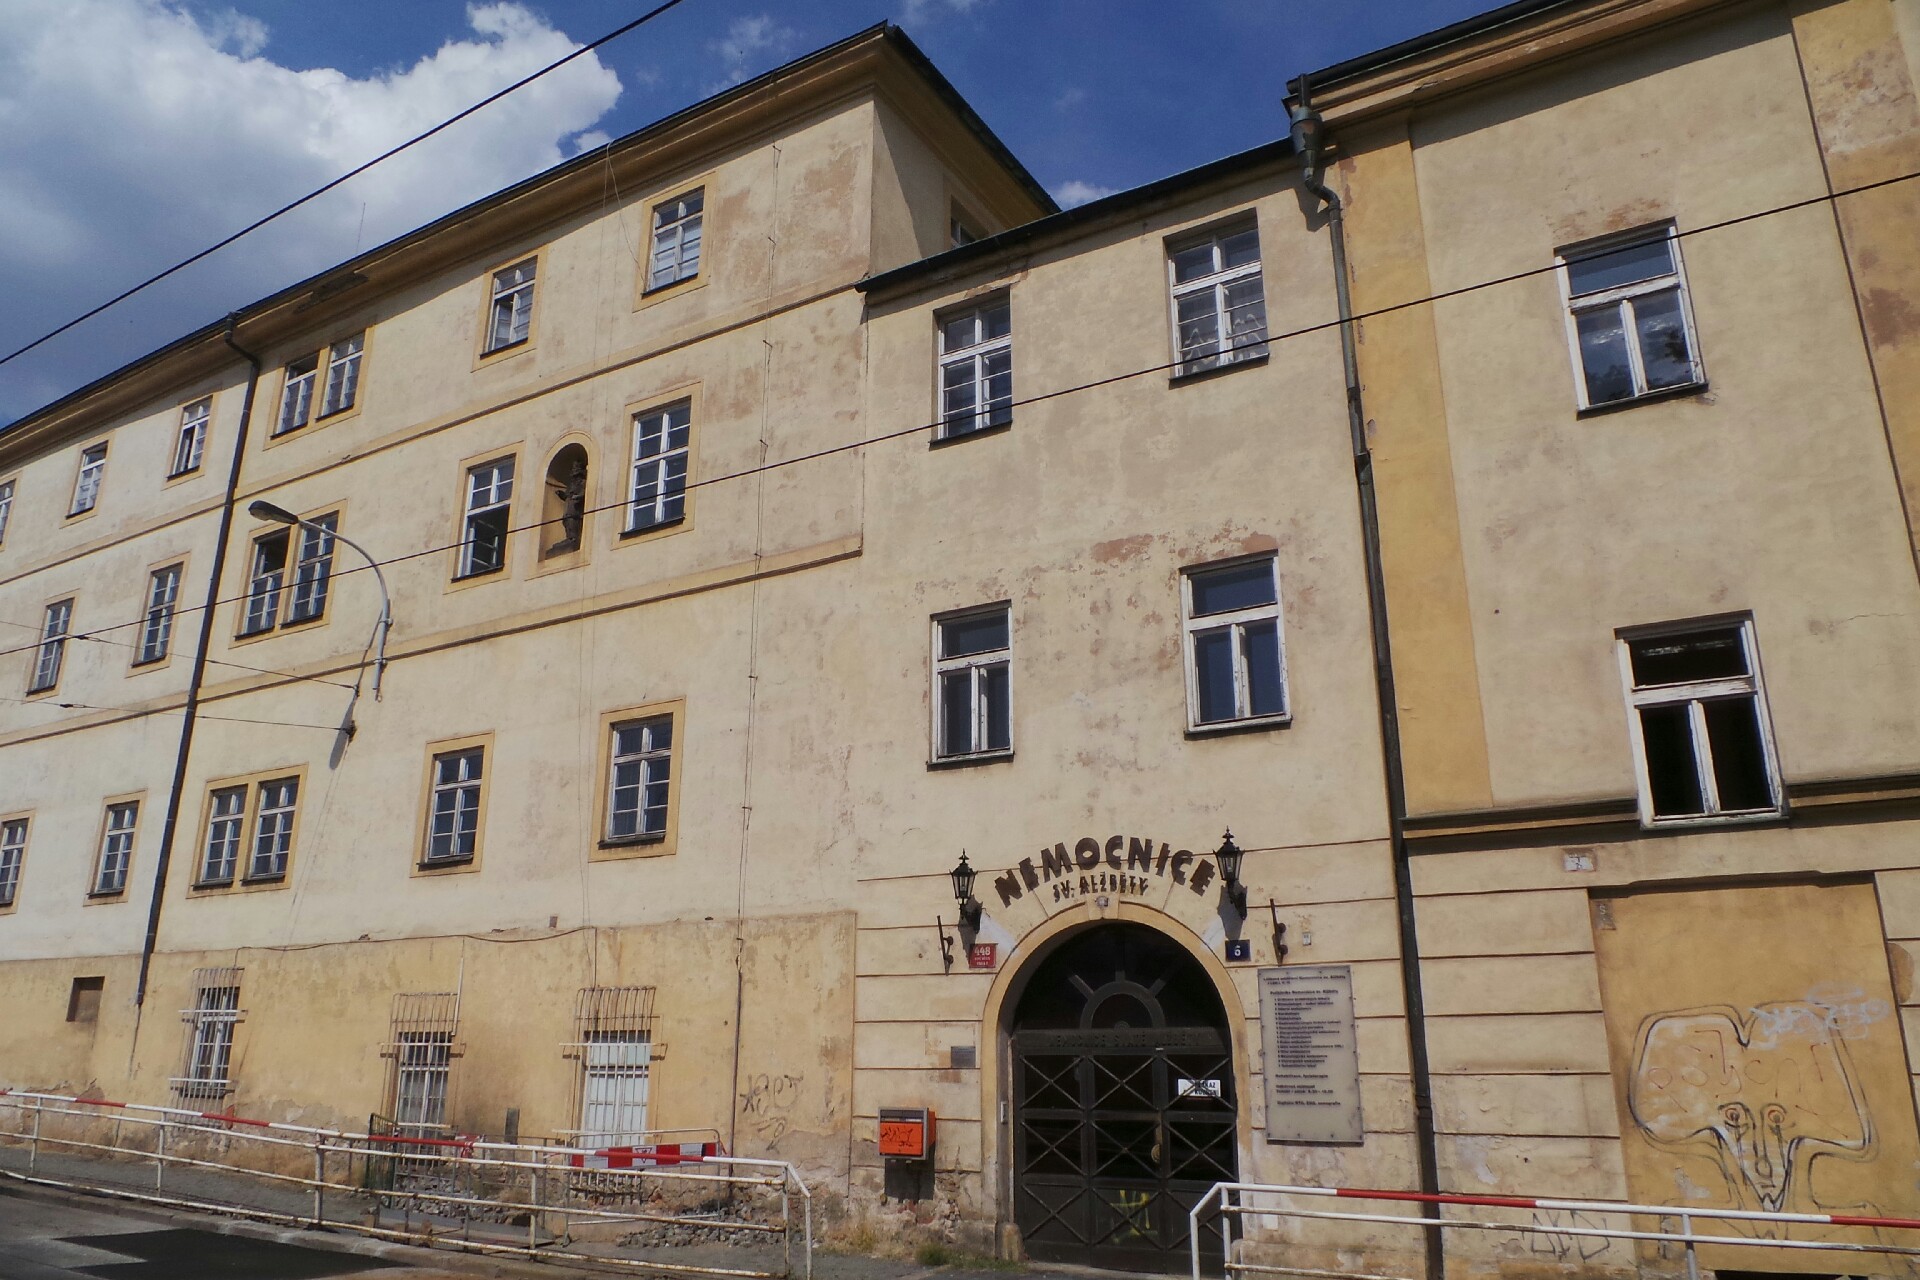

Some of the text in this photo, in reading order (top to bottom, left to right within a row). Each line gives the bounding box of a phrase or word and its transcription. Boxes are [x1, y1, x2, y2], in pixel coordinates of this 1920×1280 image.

[994, 835, 1216, 908] NEMOCNICE
[1053, 879, 1075, 903] SV.
[974, 946, 991, 956] 448
